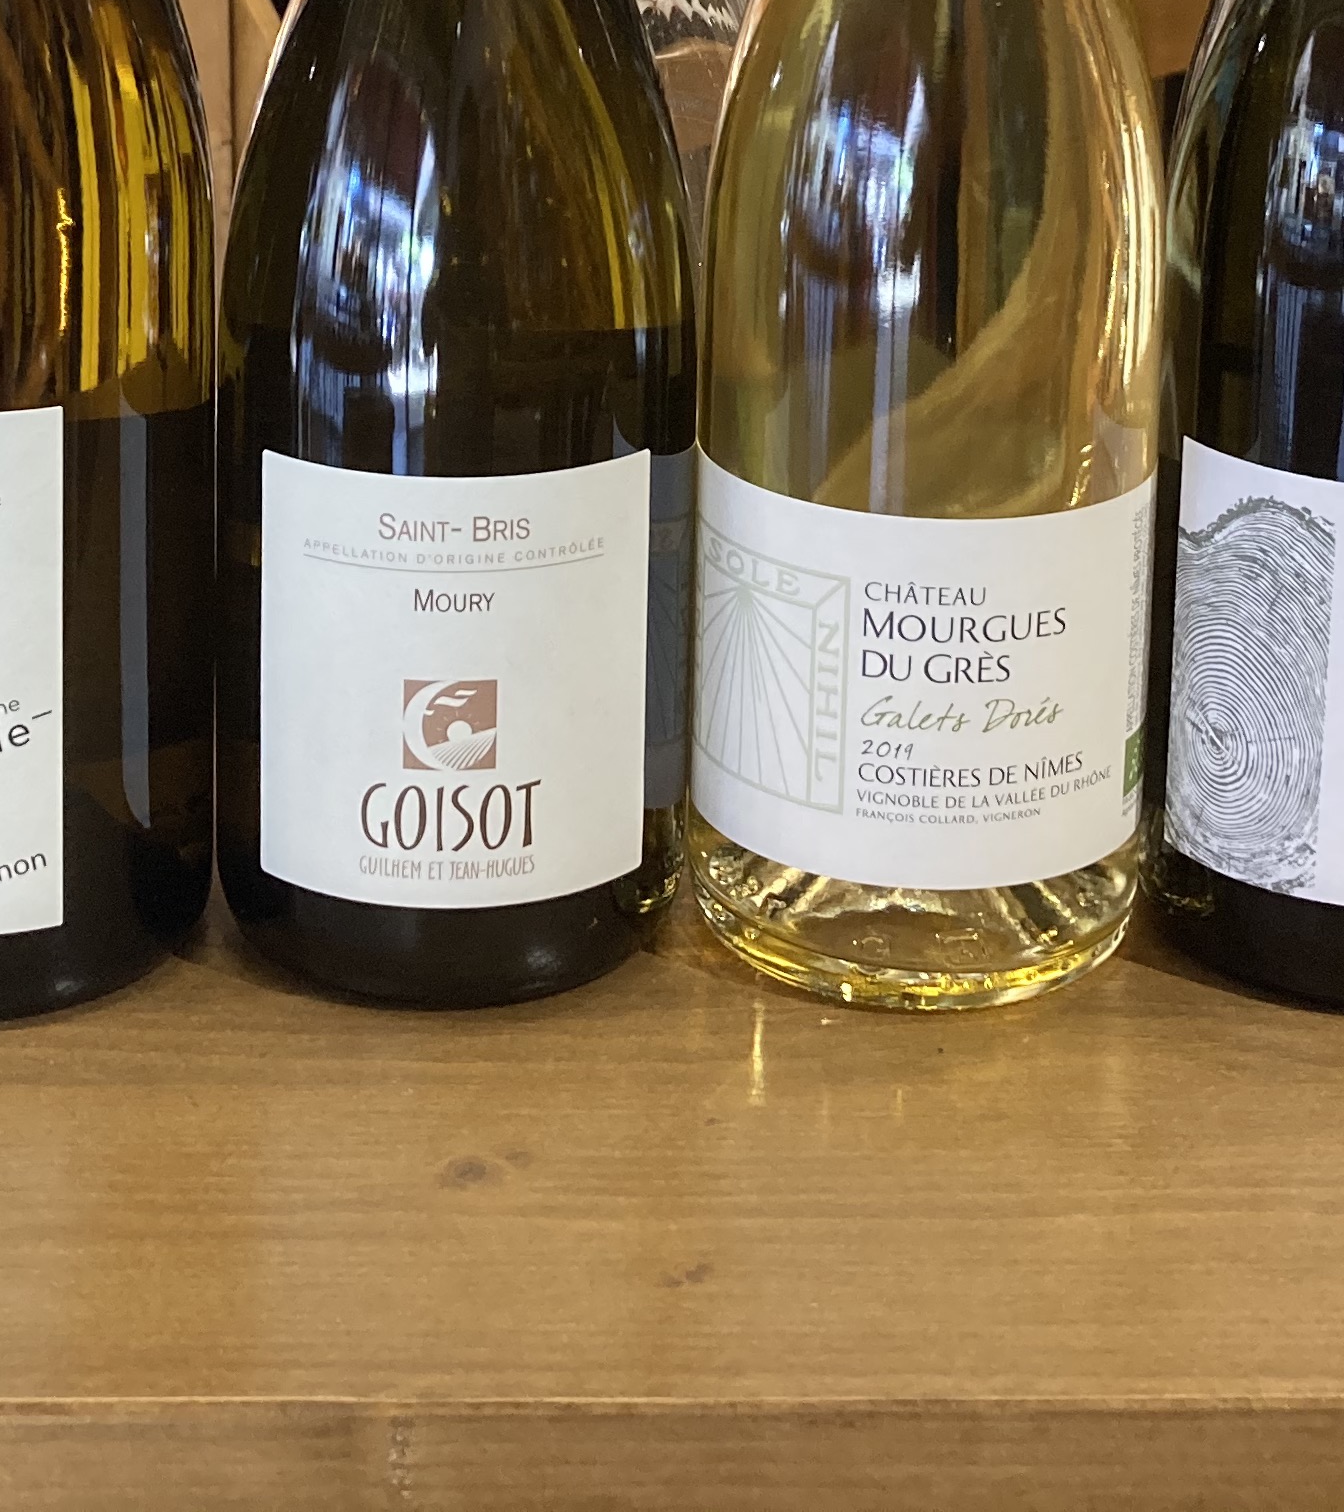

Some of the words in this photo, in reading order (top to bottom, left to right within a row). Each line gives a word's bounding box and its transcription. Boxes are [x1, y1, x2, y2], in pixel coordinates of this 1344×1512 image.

[303, 537, 407, 564] APPELLATION
[416, 552, 506, 565] D'ORIGINE
[514, 536, 605, 562] CONTRÔLÉE
[708, 535, 800, 597] SOLE
[413, 588, 496, 613] MOURY
[864, 581, 987, 607] CHÂTEAU
[862, 607, 1067, 644] MOURGUES
[861, 649, 912, 682] DU
[923, 649, 1012, 684] GRÈS
[813, 618, 841, 783] NIHIL
[860, 695, 972, 734] Galets
[982, 694, 1064, 734] Dorés
[861, 739, 914, 761] 2019
[856, 788, 940, 810] VIGNOBLE
[945, 795, 967, 809] DE
[971, 793, 990, 808] LA
[994, 786, 1046, 807] VALLÉE
[1050, 782, 1070, 799] DU
[1073, 764, 1113, 793] RHÔNE
[858, 761, 982, 788] COSTIÈRES
[989, 766, 1018, 786] DE
[1024, 751, 1084, 783] NÎMES
[360, 778, 543, 853] GOISOT
[856, 806, 915, 824] FRANÇOIS
[982, 807, 1042, 824] VIGNERON
[359, 854, 422, 879] GUILHEM
[428, 860, 445, 880] ET
[448, 855, 536, 881] JEAN-HUGUES
